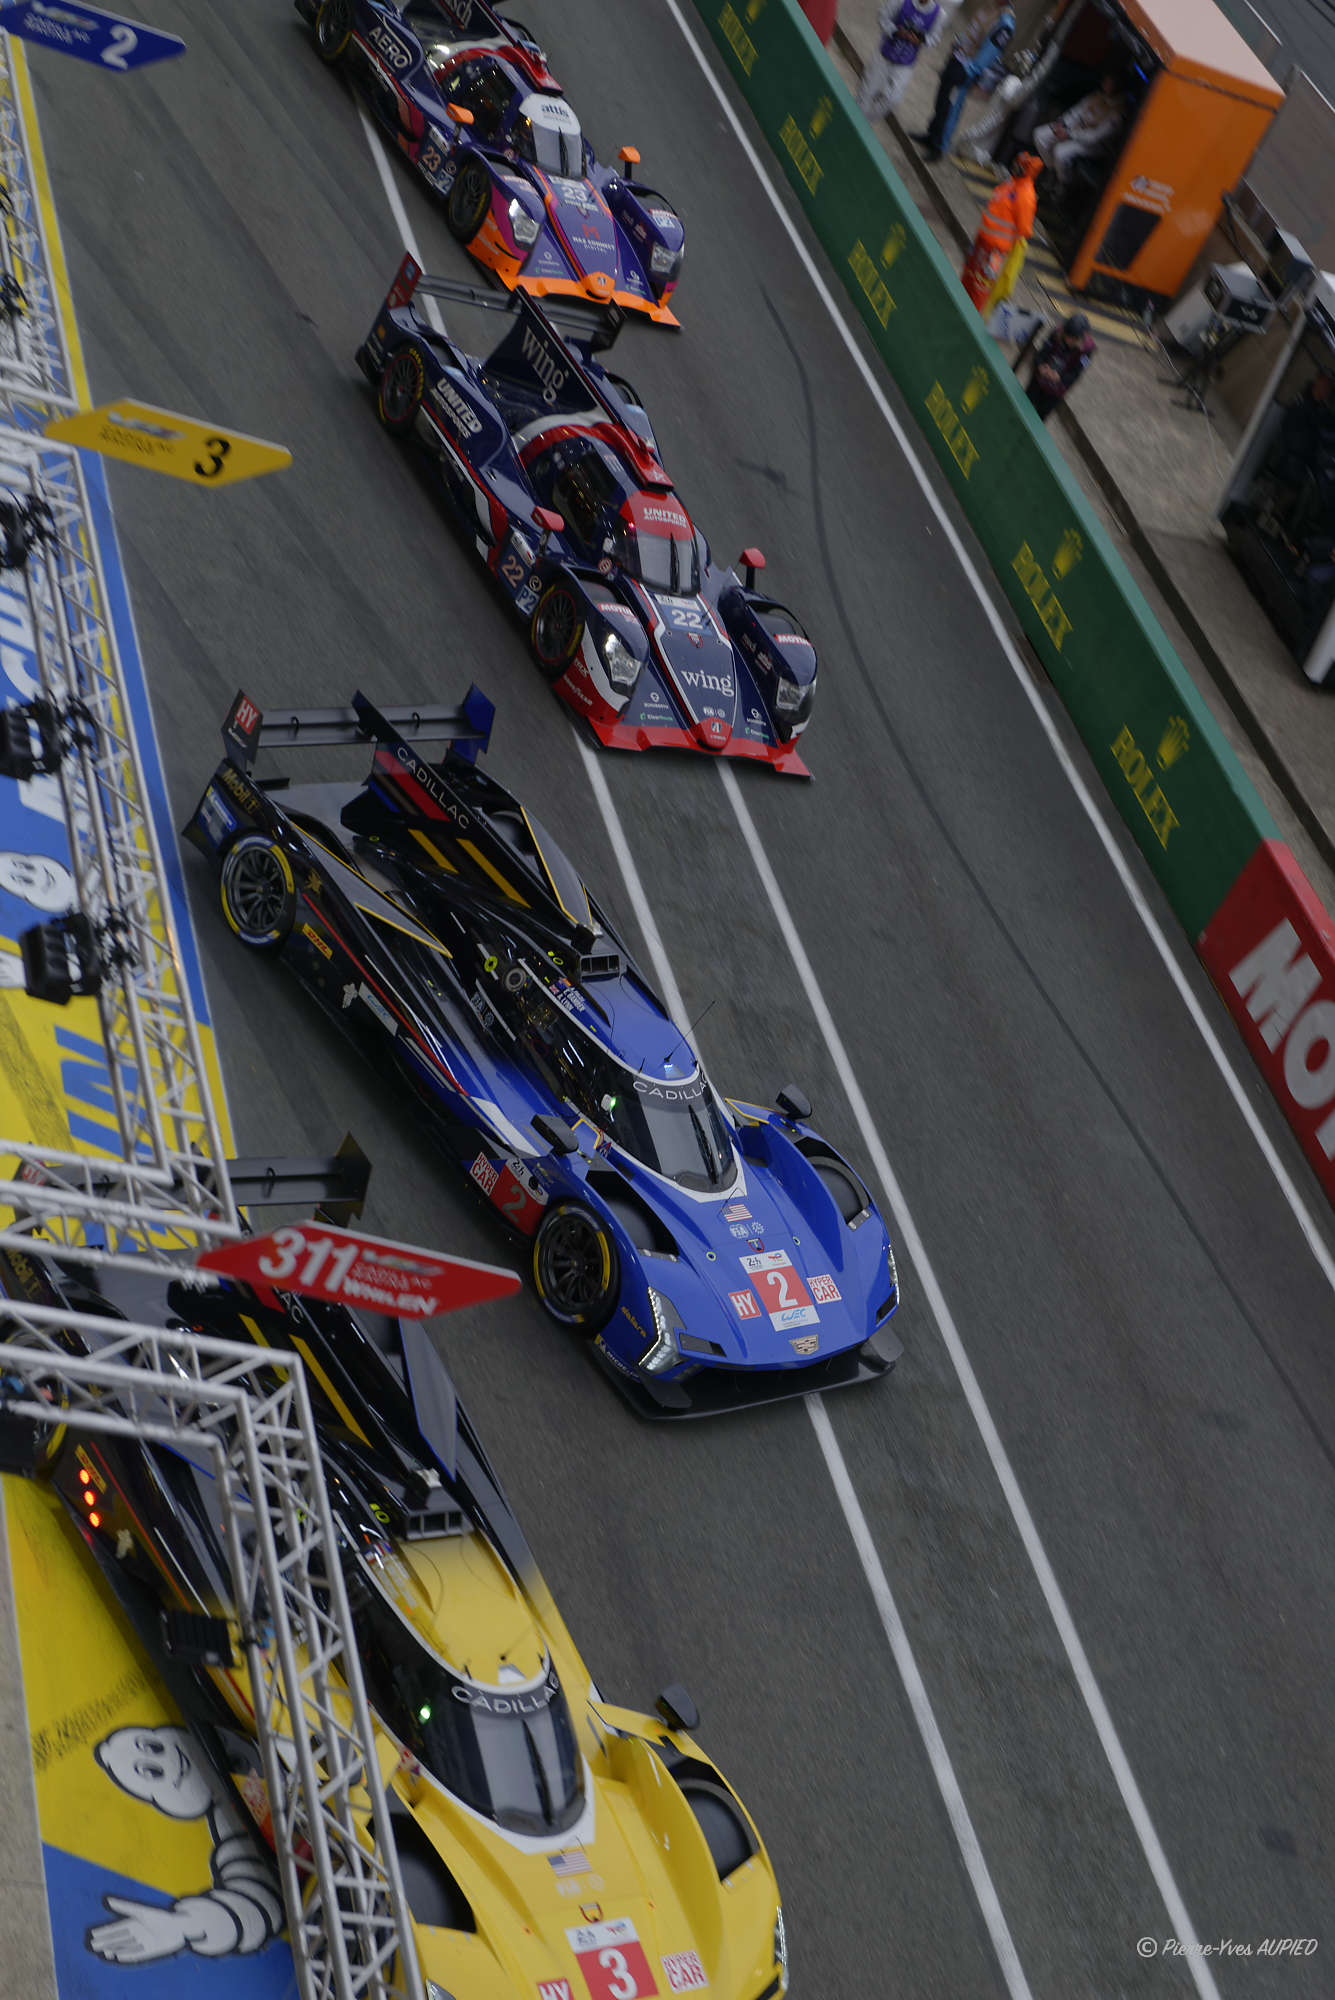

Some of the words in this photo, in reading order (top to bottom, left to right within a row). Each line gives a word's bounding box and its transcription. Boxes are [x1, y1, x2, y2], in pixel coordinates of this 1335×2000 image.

[100, 24, 138, 70] 2
[368, 26, 408, 69] AERO
[422, 145, 441, 173] 23
[778, 112, 824, 197] ROLEX
[561, 186, 588, 201] 23
[848, 239, 897, 331] ROLEX
[522, 324, 569, 405] wing
[437, 377, 482, 432] UNITED
[924, 379, 980, 480] ROLEX
[194, 436, 231, 478] 3
[643, 507, 687, 523] UNITED
[501, 555, 524, 588] 22
[518, 588, 538, 612] P2
[1011, 541, 1073, 654] ROLEX
[671, 610, 704, 630] 22
[681, 669, 735, 697] wing
[237, 699, 257, 729] HY
[396, 747, 470, 830] CADILLAC
[1110, 724, 1180, 851] ROLEX
[1229, 916, 1335, 1162] MO
[633, 1072, 708, 1100] CADILLAC
[472, 1162, 493, 1193] CAR
[479, 1154, 497, 1182] HYPER
[502, 1184, 526, 1222] 2
[258, 1228, 359, 1293] 311
[767, 1271, 798, 1308] 2
[810, 1275, 834, 1288] HYPER
[813, 1284, 839, 1302] CAR
[731, 1292, 757, 1317] HY
[451, 1671, 560, 1714] CADILLAC
[599, 1948, 638, 2000] 3
